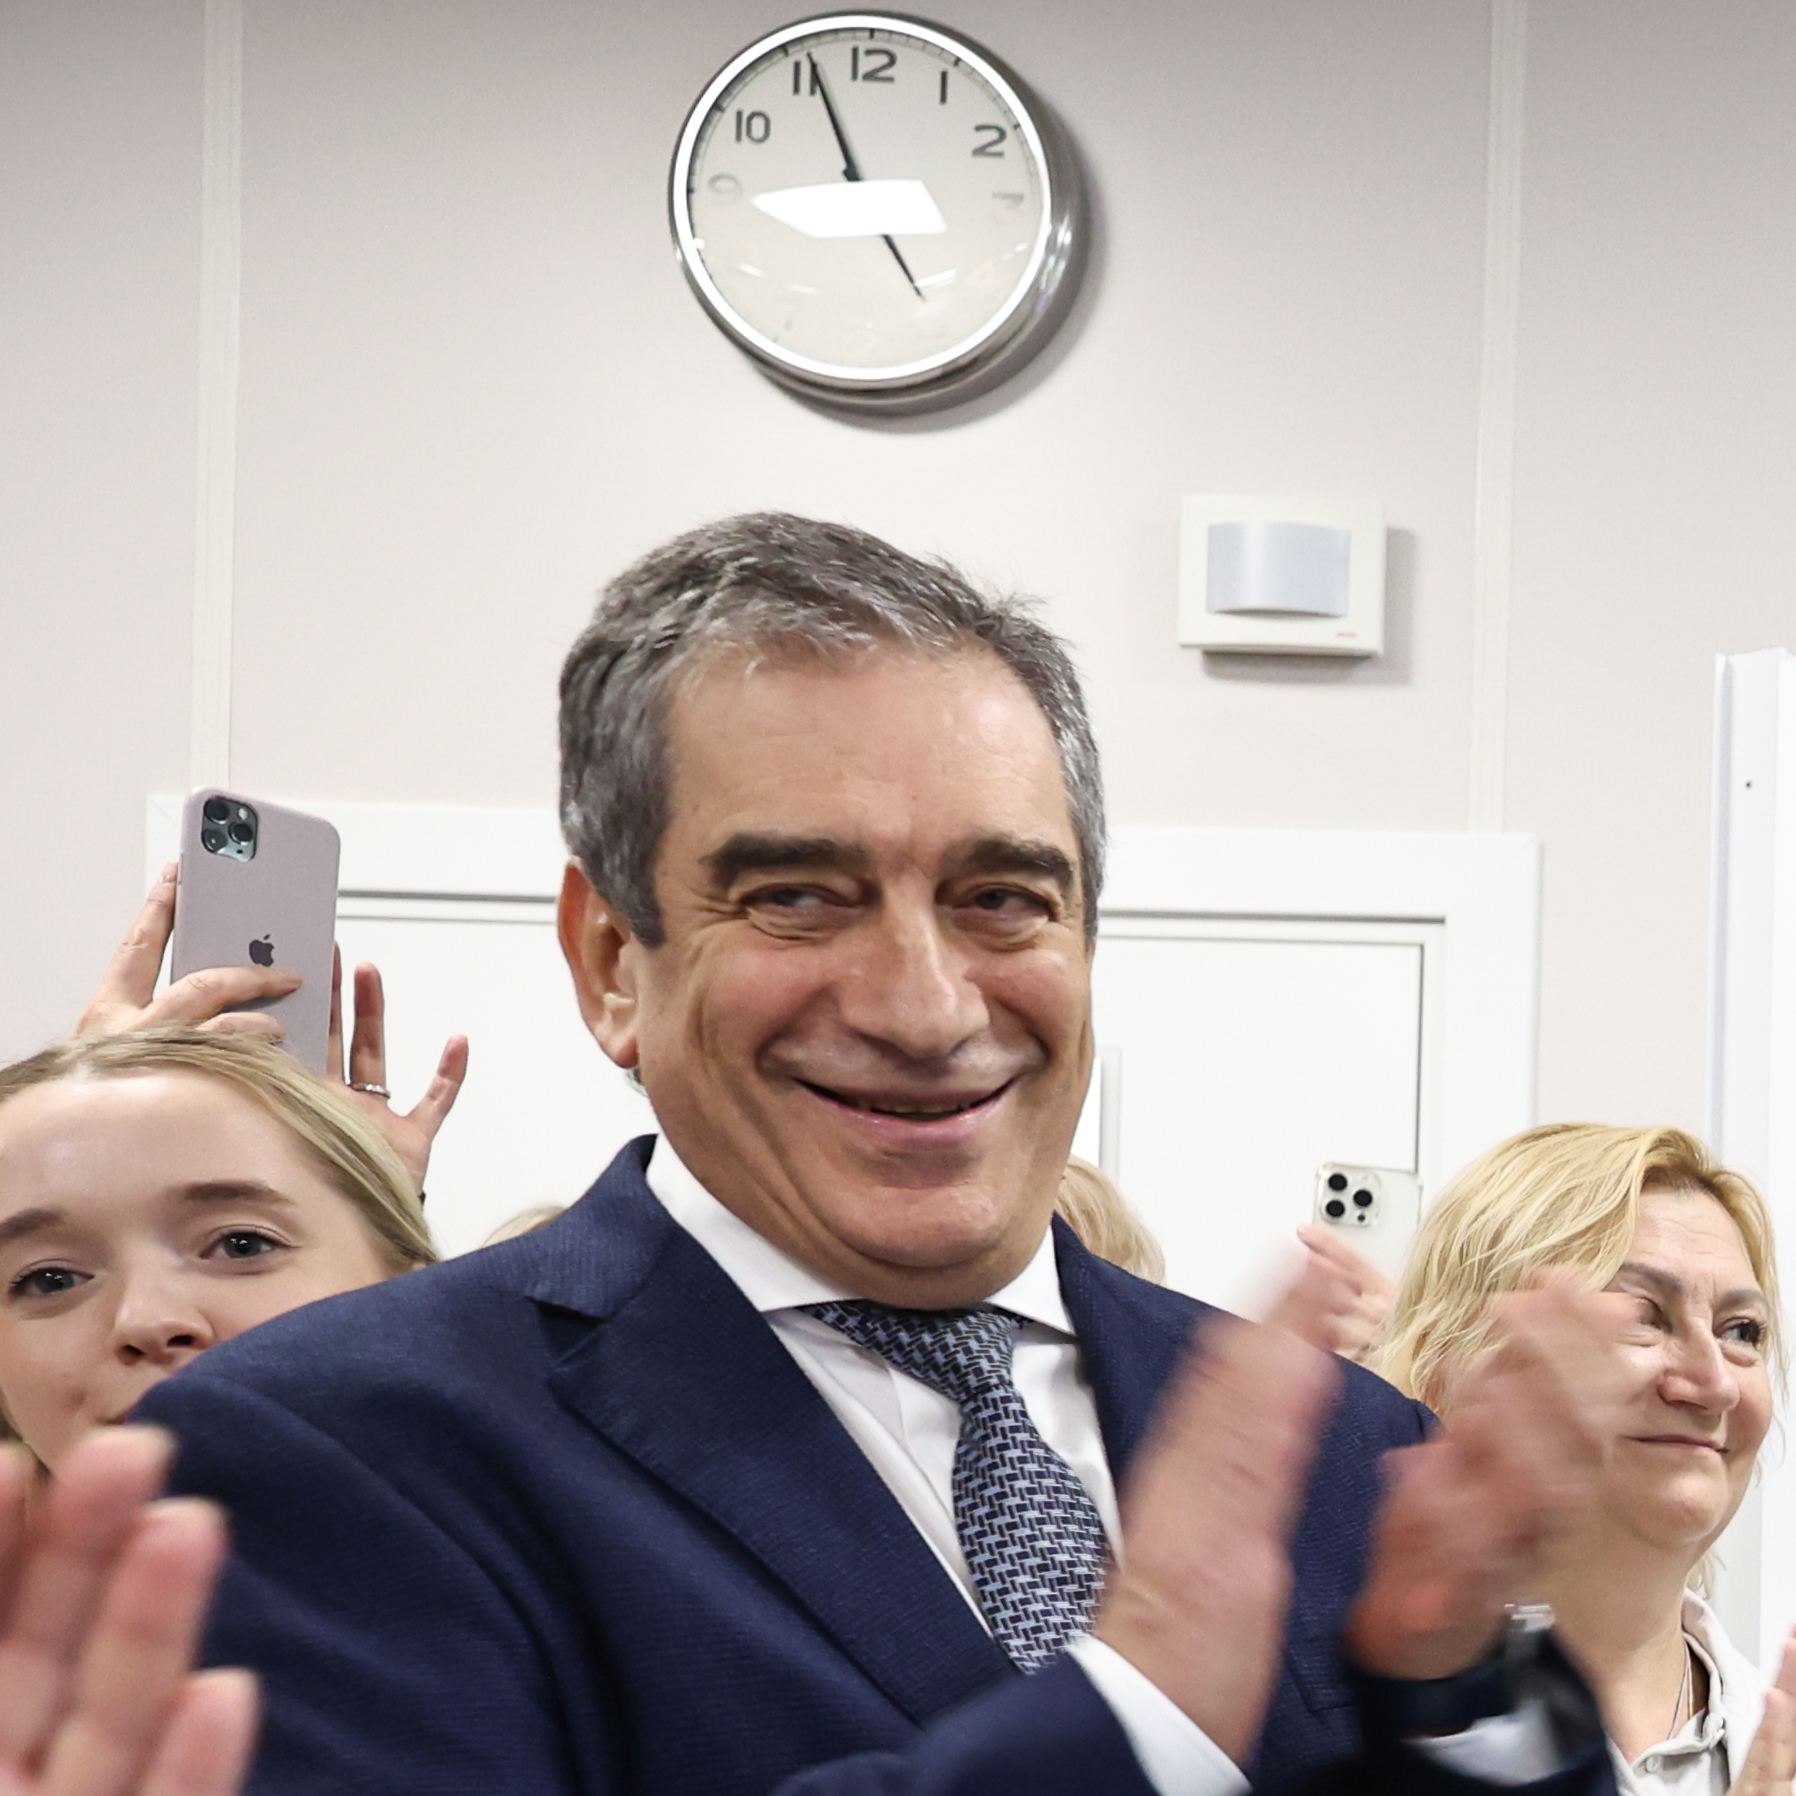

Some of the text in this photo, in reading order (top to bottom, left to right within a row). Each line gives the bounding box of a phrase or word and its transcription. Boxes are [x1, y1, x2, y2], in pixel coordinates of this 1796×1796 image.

[792, 60, 818, 97] 11
[850, 45, 898, 83] 12
[940, 69, 948, 105] 1
[735, 109, 771, 144] 10
[971, 123, 1007, 158] 2
